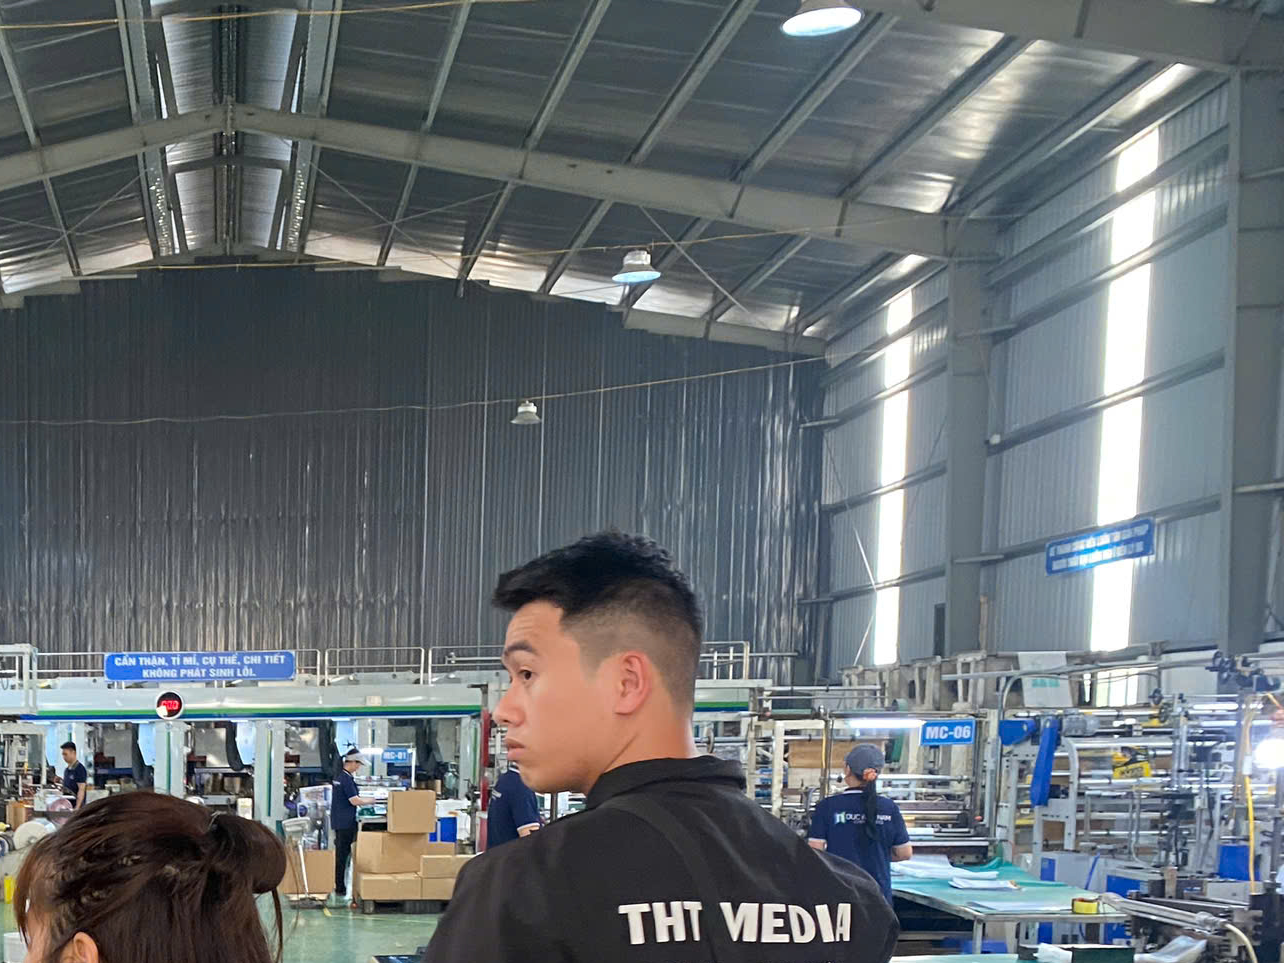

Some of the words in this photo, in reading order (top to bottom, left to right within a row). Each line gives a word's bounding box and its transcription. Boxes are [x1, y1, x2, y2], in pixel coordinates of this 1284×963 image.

[209, 668, 235, 677] SINH
[925, 725, 972, 740] MC-06
[618, 901, 703, 945] THT
[719, 902, 852, 944] MEDIA
